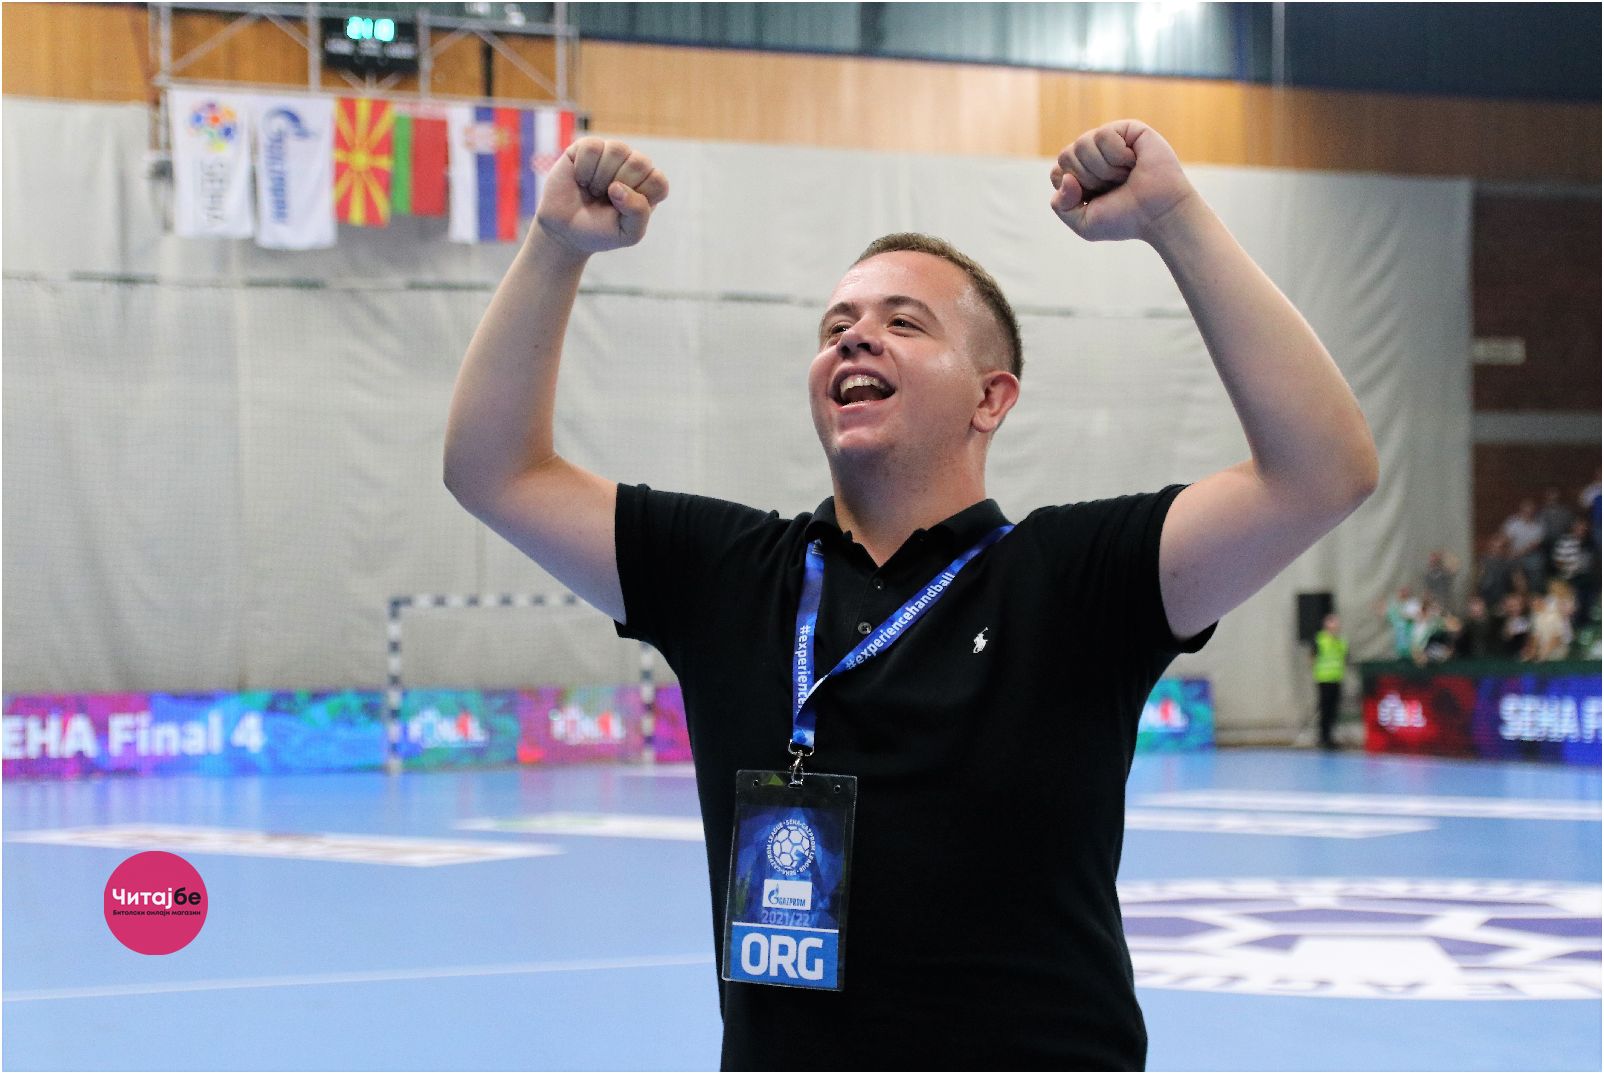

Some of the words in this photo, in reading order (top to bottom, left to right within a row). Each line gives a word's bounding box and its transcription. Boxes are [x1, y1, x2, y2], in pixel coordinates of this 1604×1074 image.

[845, 572, 956, 671] #experiencehandball
[795, 624, 811, 709] #experience
[108, 710, 223, 756] Final
[231, 711, 266, 753] 4
[761, 910, 811, 927] 2021/22
[740, 932, 824, 980] ORG
